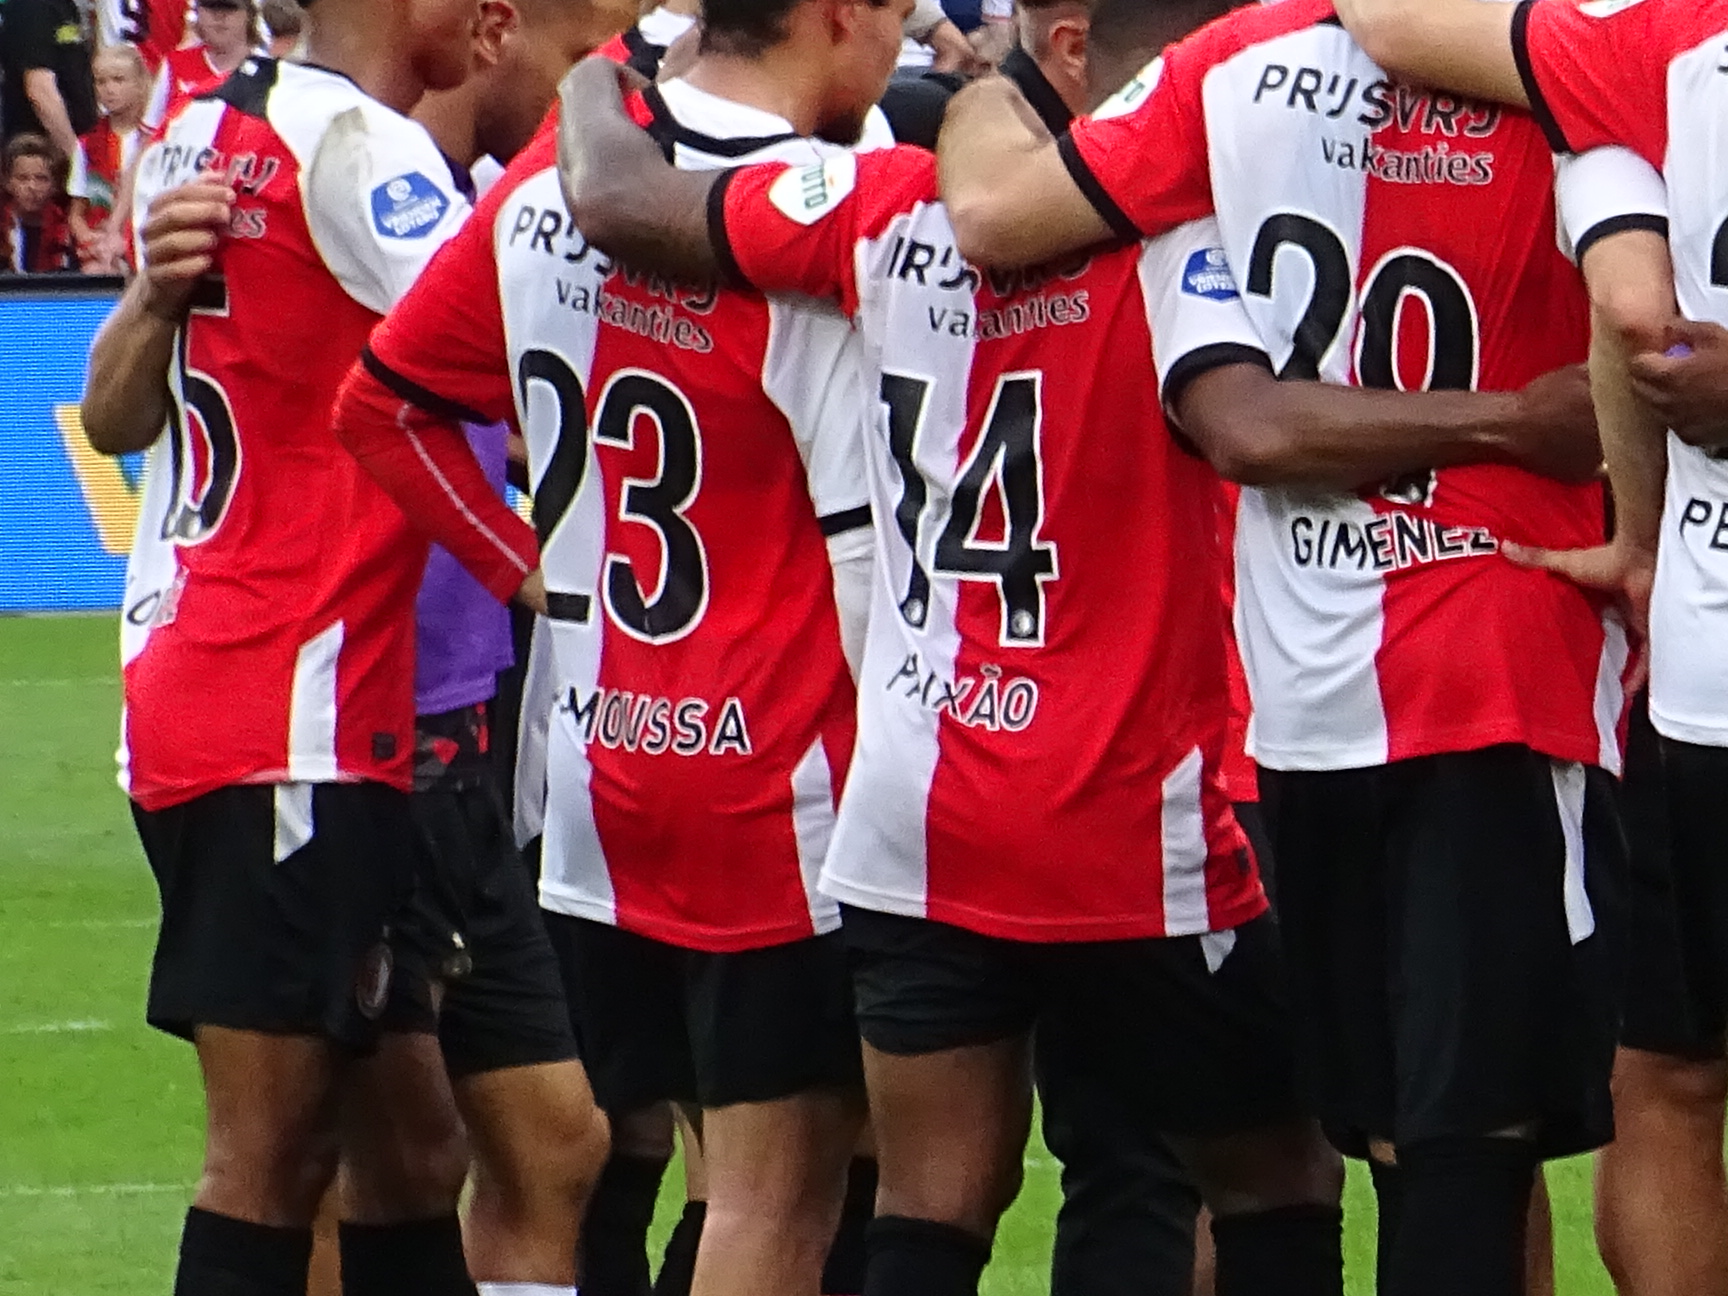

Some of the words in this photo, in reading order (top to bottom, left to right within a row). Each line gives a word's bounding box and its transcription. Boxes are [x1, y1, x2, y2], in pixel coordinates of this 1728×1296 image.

[1321, 136, 1494, 185] vakanties
[556, 276, 714, 353] vakanties
[1246, 211, 1480, 506] 20
[517, 348, 710, 645] 23
[880, 368, 1061, 648] 14
[559, 685, 753, 756] MOUSSA
